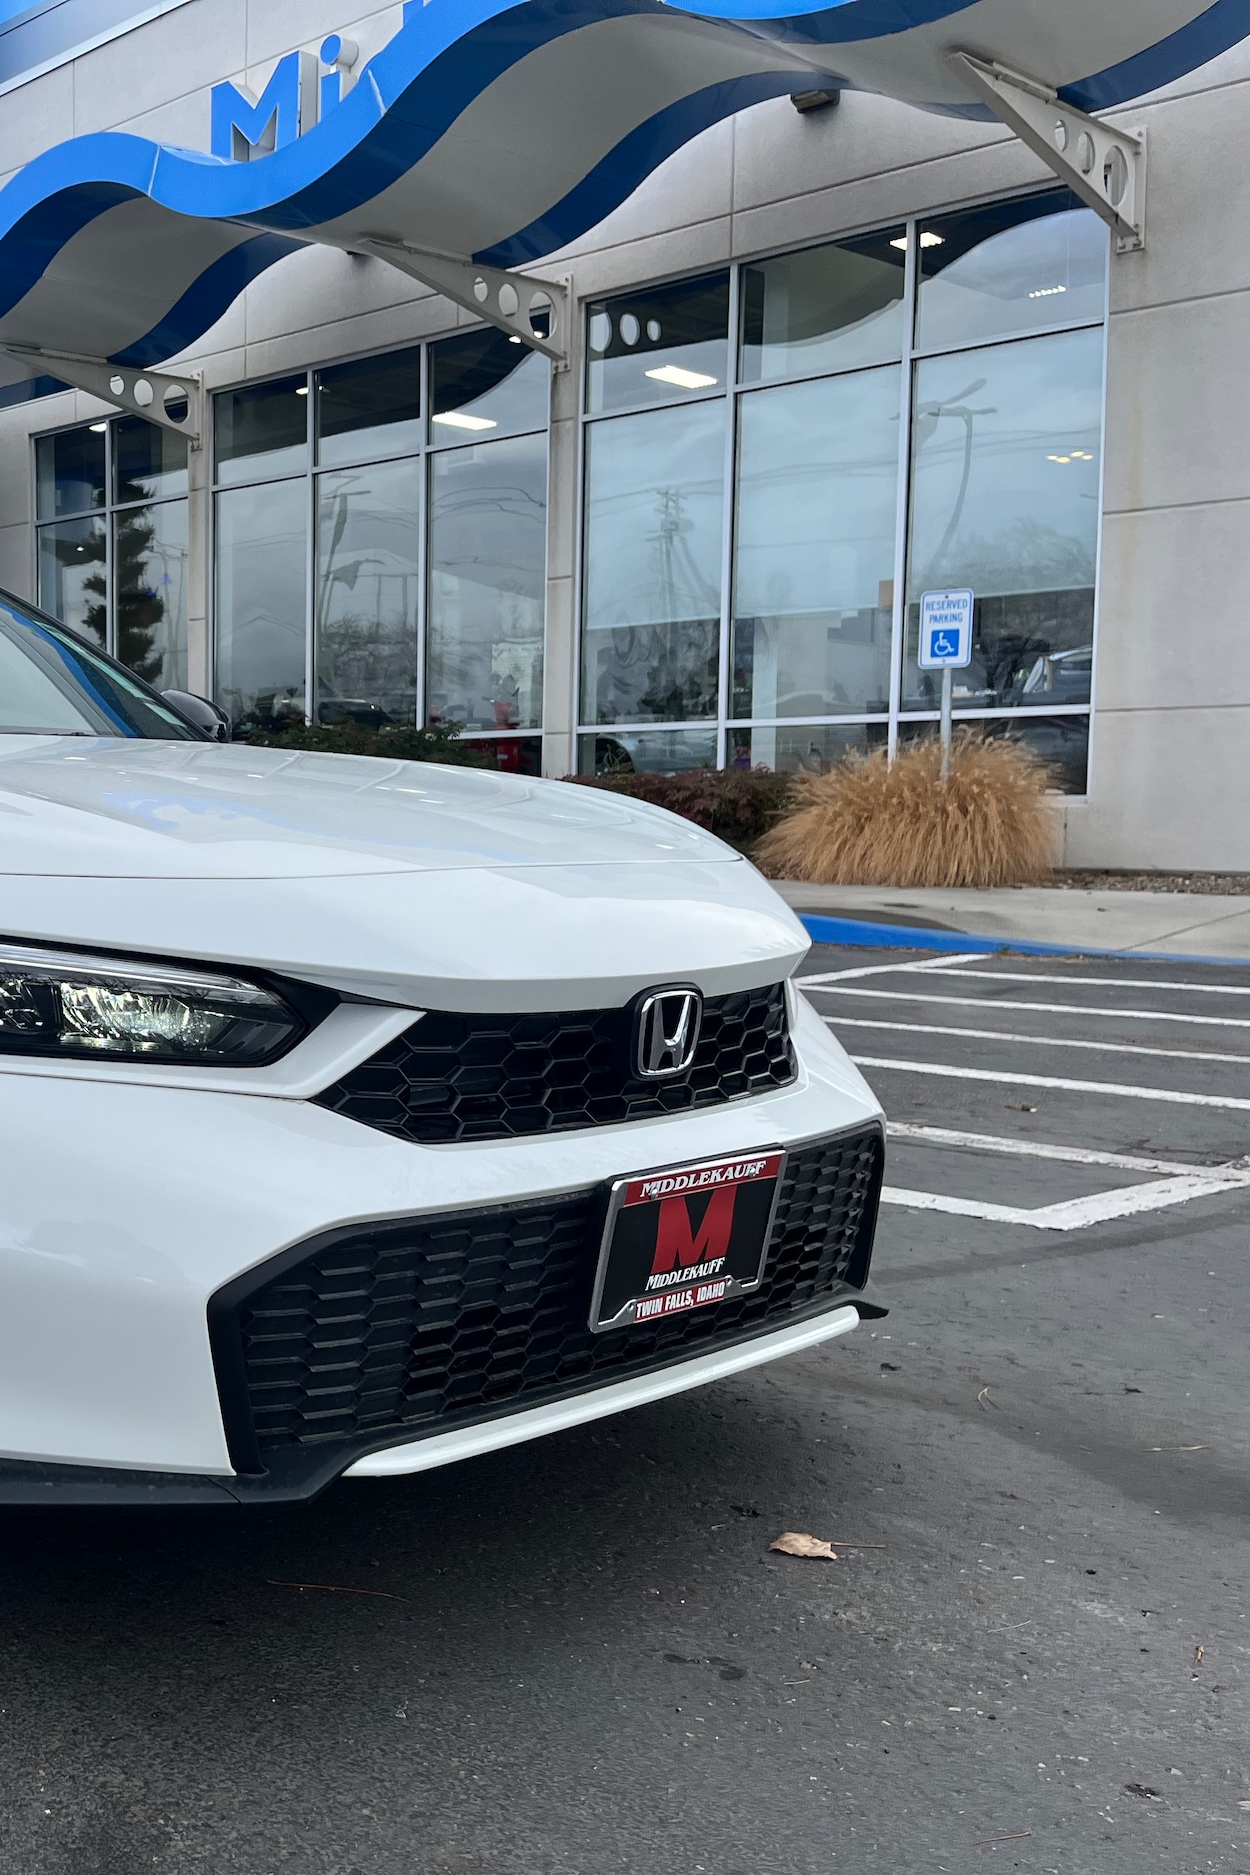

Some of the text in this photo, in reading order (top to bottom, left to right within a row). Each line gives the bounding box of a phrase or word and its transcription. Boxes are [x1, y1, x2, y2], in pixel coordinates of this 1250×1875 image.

[925, 599, 968, 611] RESERVED
[929, 612, 963, 624] PARKING
[639, 1160, 767, 1198] MIDDLEKAUFF
[651, 1184, 738, 1274] M
[645, 1256, 726, 1291] MIDDLEKAUFF
[636, 1281, 726, 1319] TWIN FALLS, IDAHO
